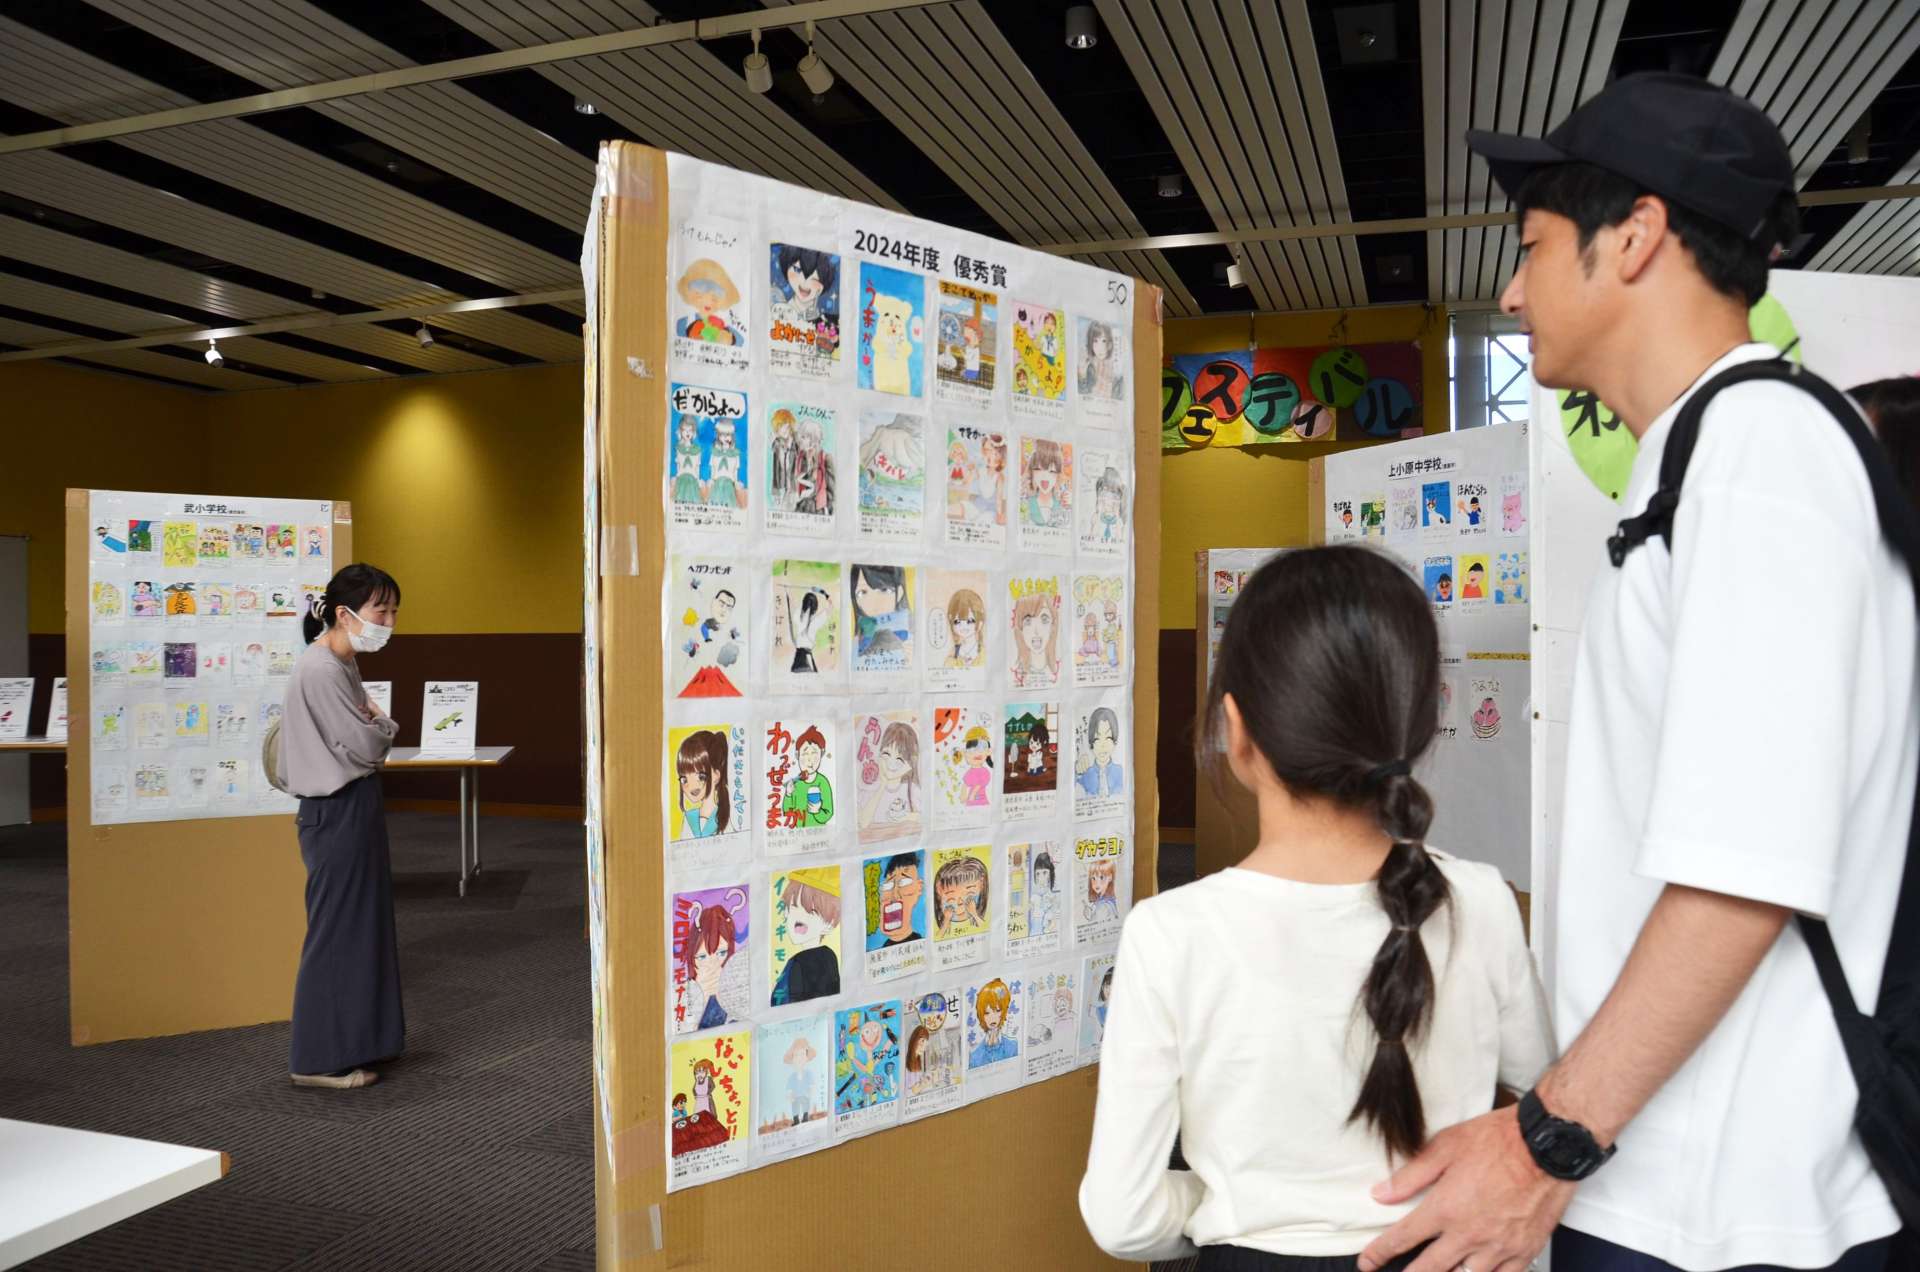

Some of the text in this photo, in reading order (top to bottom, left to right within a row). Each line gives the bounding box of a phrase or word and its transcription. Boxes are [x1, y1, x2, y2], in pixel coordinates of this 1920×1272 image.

[854, 229, 1008, 288] 2024年度 優秀賞
[1108, 280, 1128, 305] 50
[1388, 456, 1443, 478] 上小原中学校
